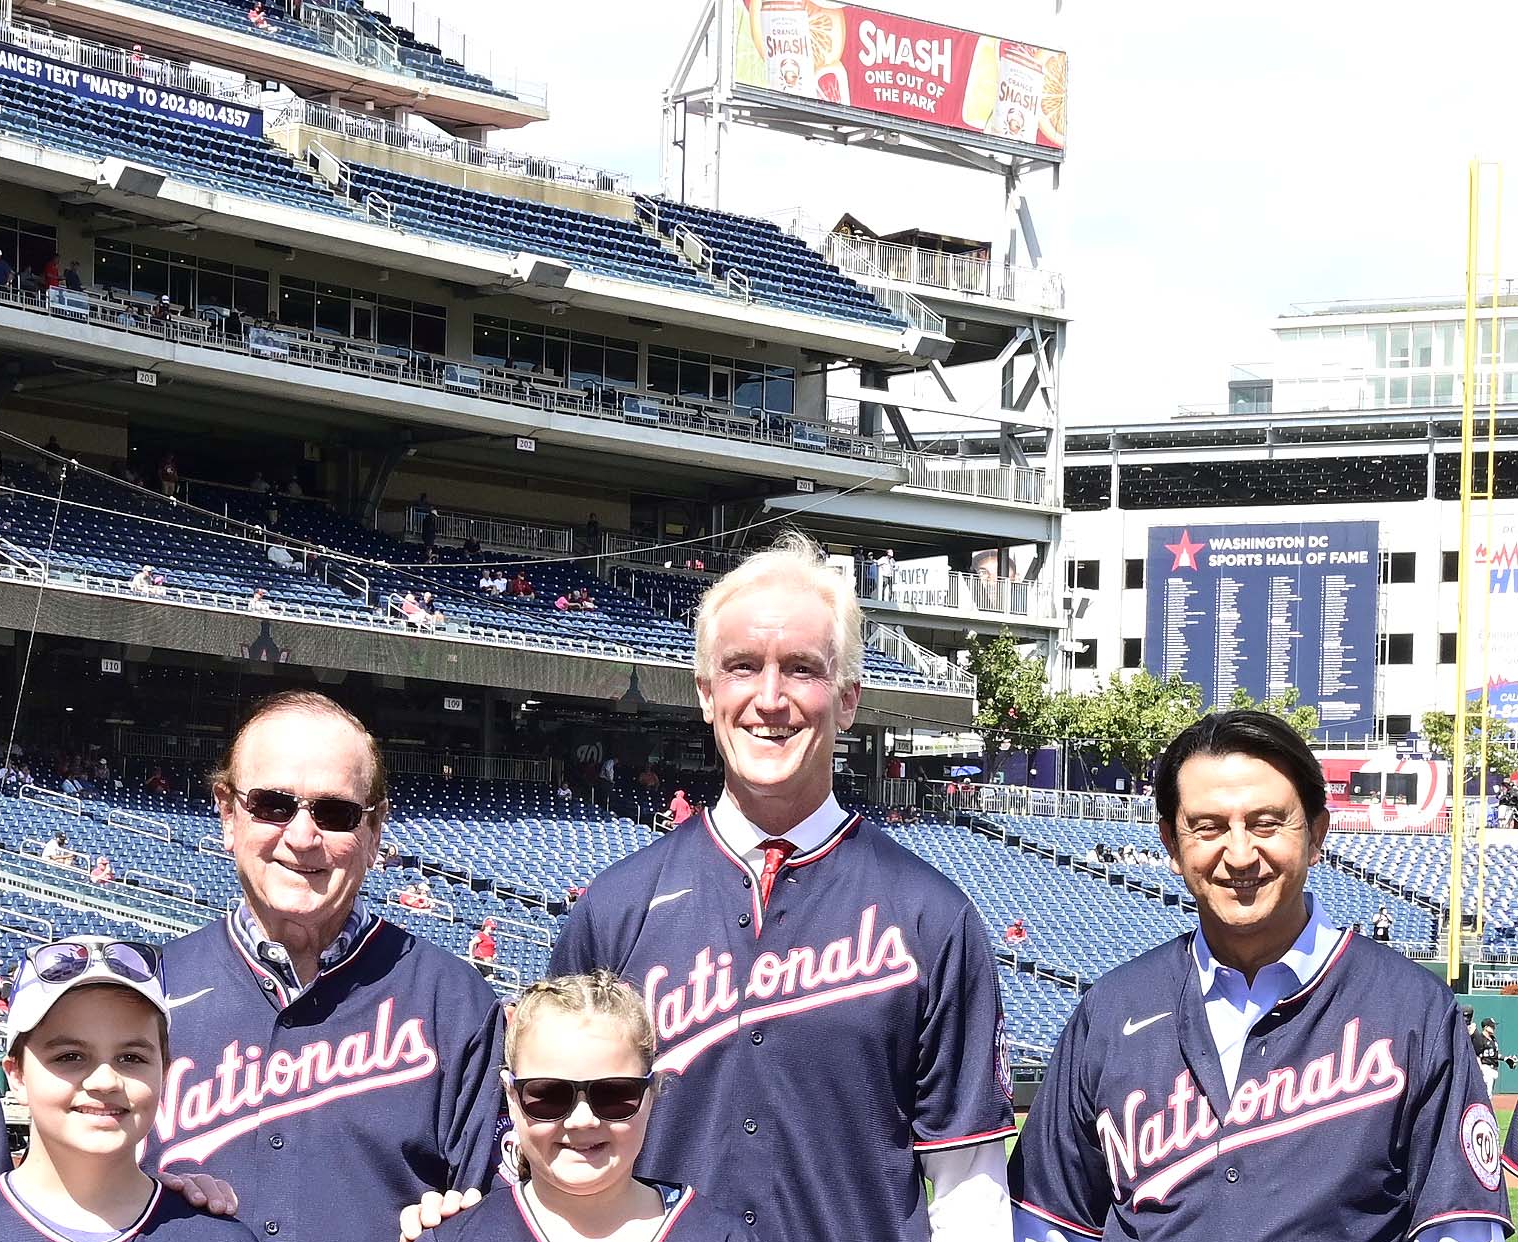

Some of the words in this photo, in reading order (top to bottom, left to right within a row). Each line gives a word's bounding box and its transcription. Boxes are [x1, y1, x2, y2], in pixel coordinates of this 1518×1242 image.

[766, 35, 809, 58] SMASH
[858, 19, 952, 84] SMASH
[45, 65, 79, 88] TEXT
[137, 87, 157, 106] TO
[160, 93, 250, 128] 202.980.4357
[865, 71, 894, 84] ONE
[896, 73, 925, 91] OUT
[926, 82, 946, 99] OF
[999, 80, 1039, 116] SMASH
[873, 88, 899, 103] THE
[902, 93, 936, 114] PARK
[1208, 537, 1304, 550] WASHINGTON
[1308, 536, 1329, 548] DC
[1208, 554, 1262, 567] SPORTS
[1267, 553, 1303, 565] HALL
[1306, 553, 1327, 564] OF
[1330, 551, 1369, 564] FAME
[1096, 1016, 1406, 1213] Nationals
